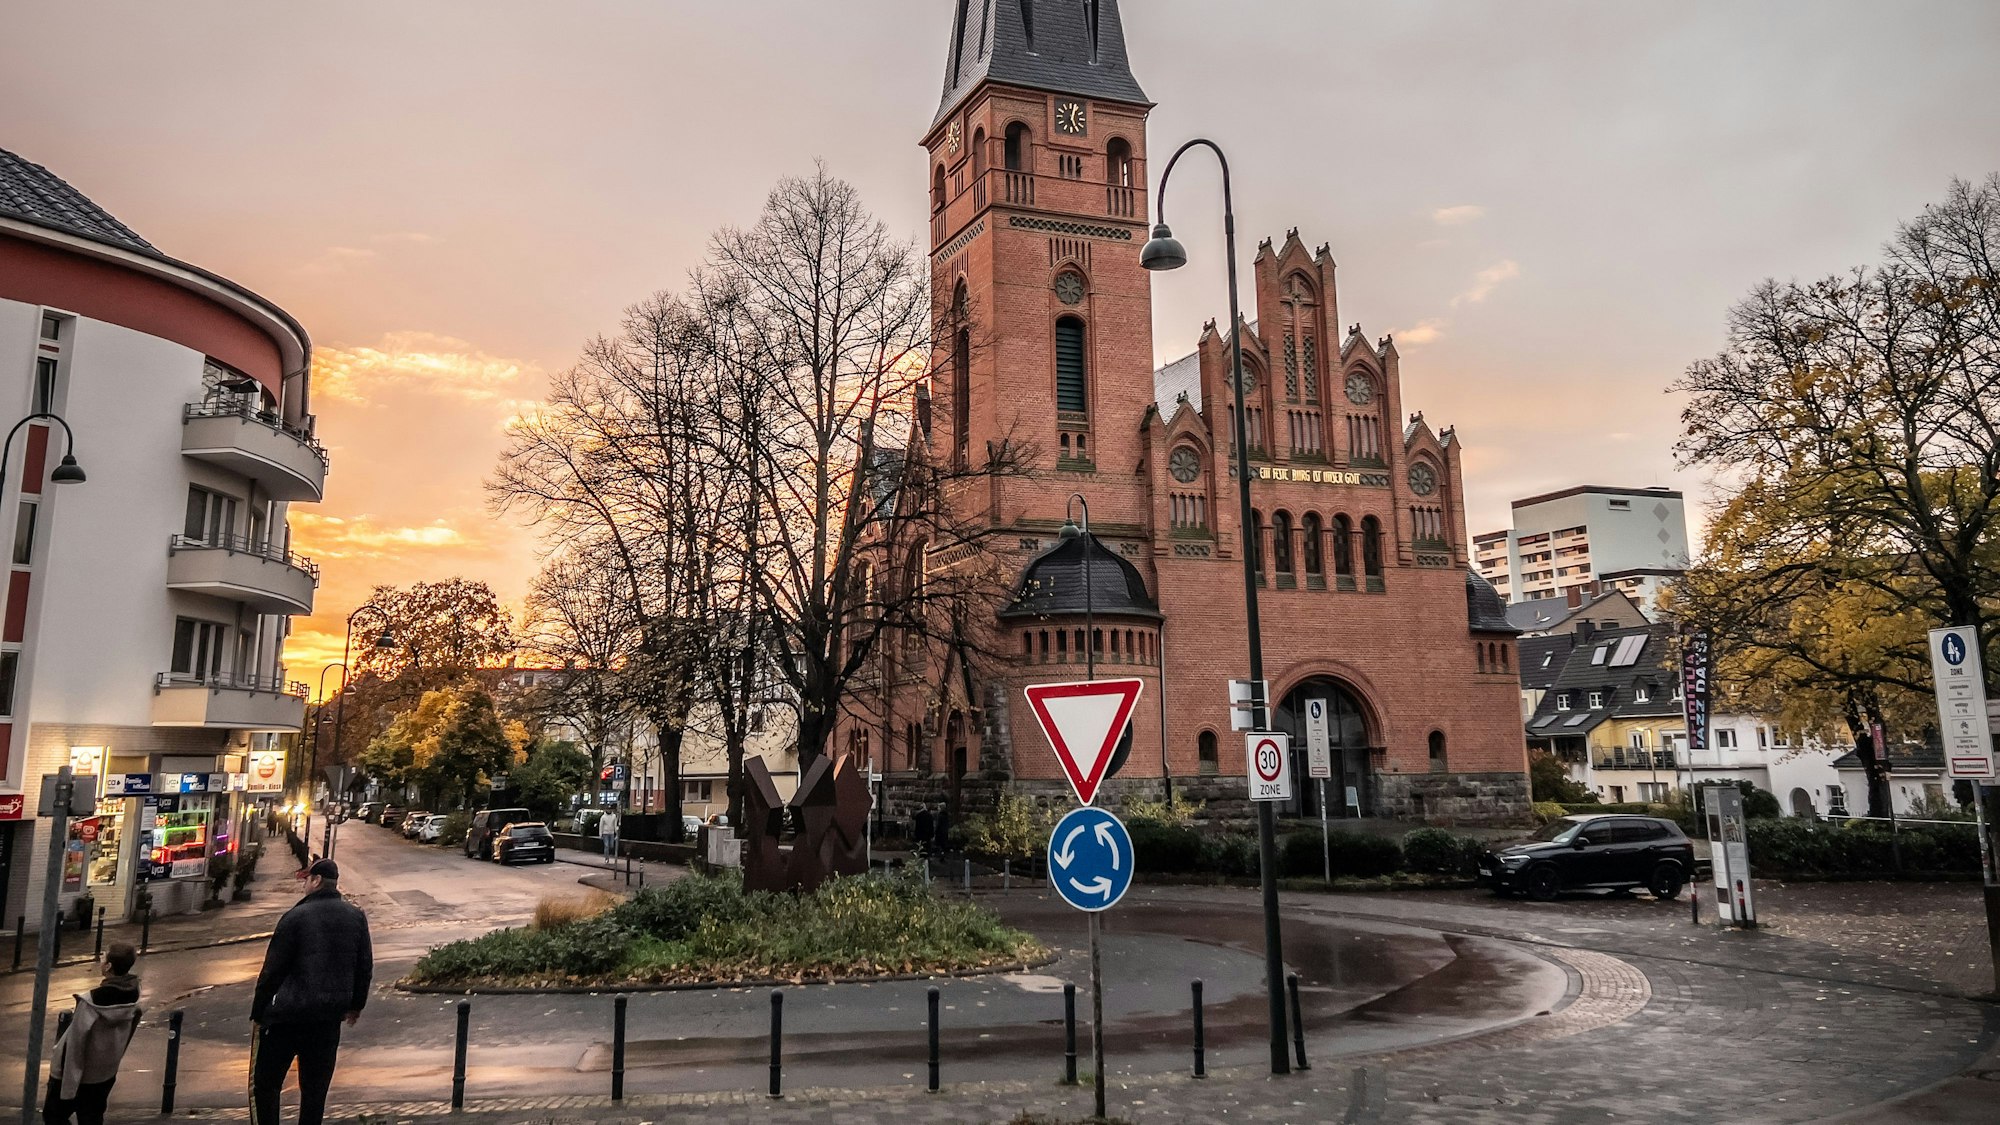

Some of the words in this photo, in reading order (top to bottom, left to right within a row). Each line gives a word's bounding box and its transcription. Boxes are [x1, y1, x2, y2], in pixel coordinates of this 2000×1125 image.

[1696, 699, 1705, 748] JAZZ
[1260, 750, 1276, 769] 30
[1260, 784, 1281, 795] ZONE
